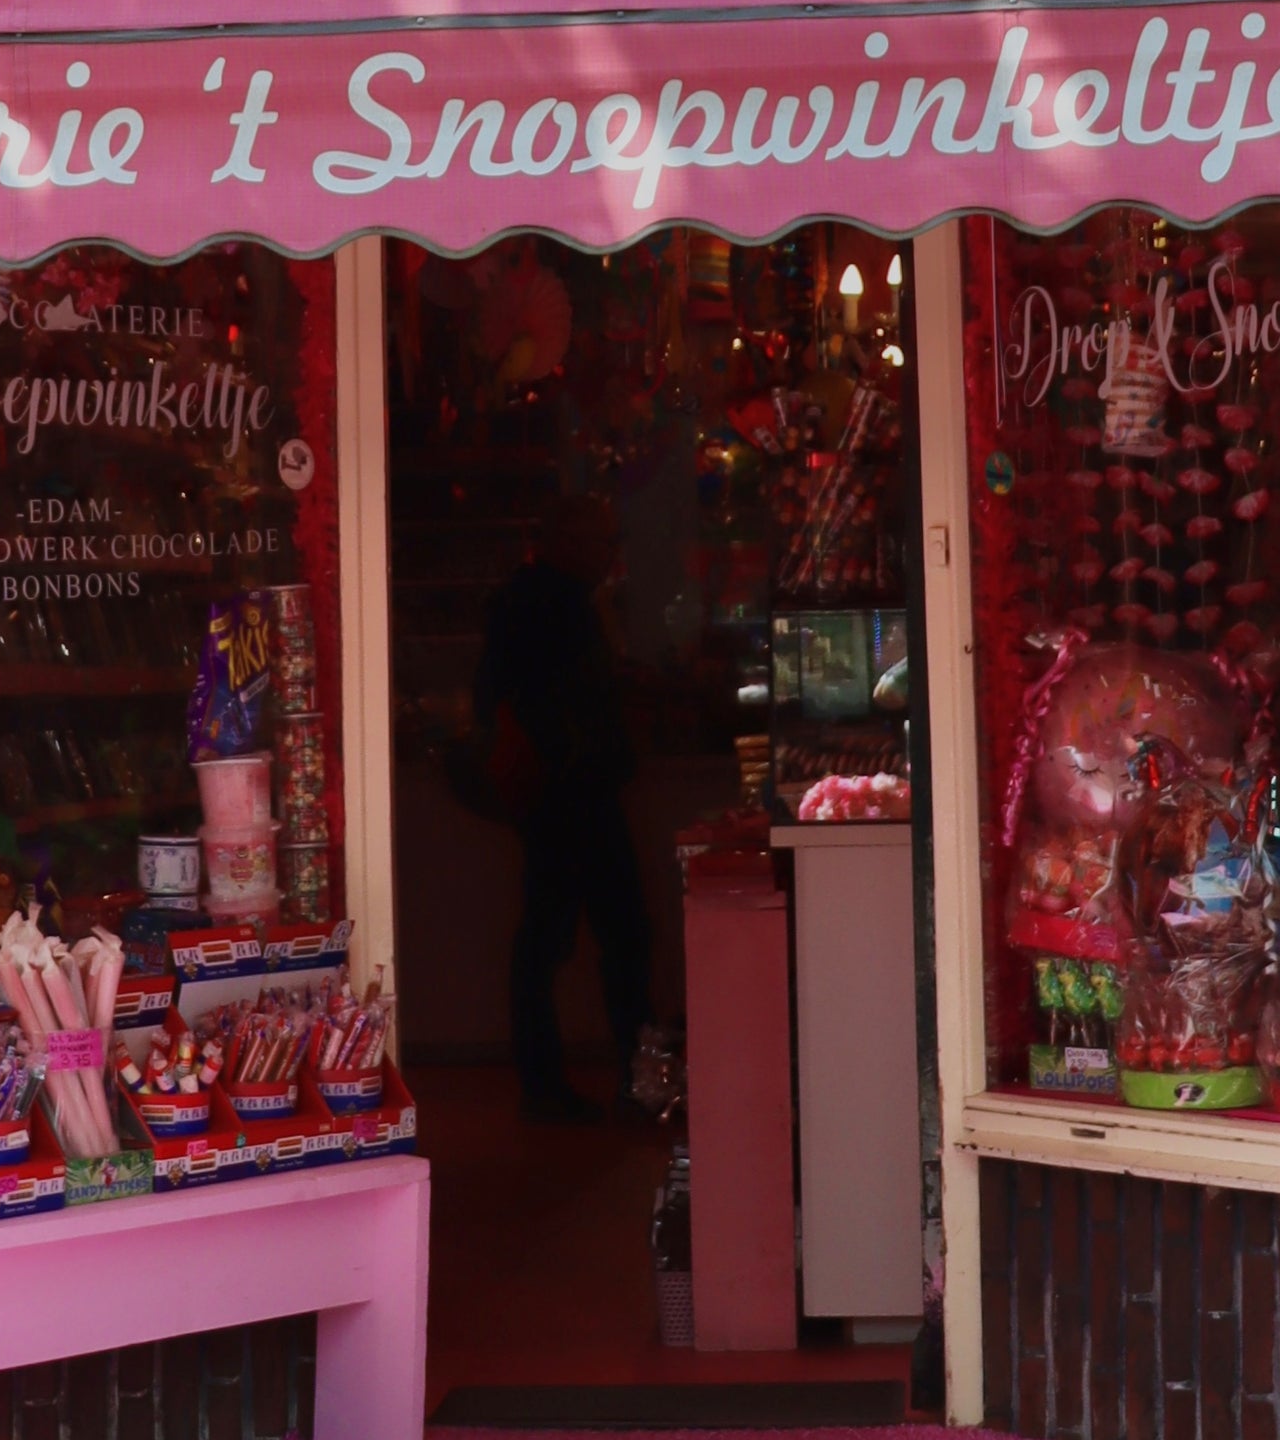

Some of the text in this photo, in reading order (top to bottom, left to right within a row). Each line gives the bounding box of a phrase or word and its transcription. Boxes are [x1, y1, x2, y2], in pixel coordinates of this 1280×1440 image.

[1003, 284, 1131, 408] Drop
[110, 527, 280, 560] CHOCOLADE
[1, 571, 142, 602] BONBONS
